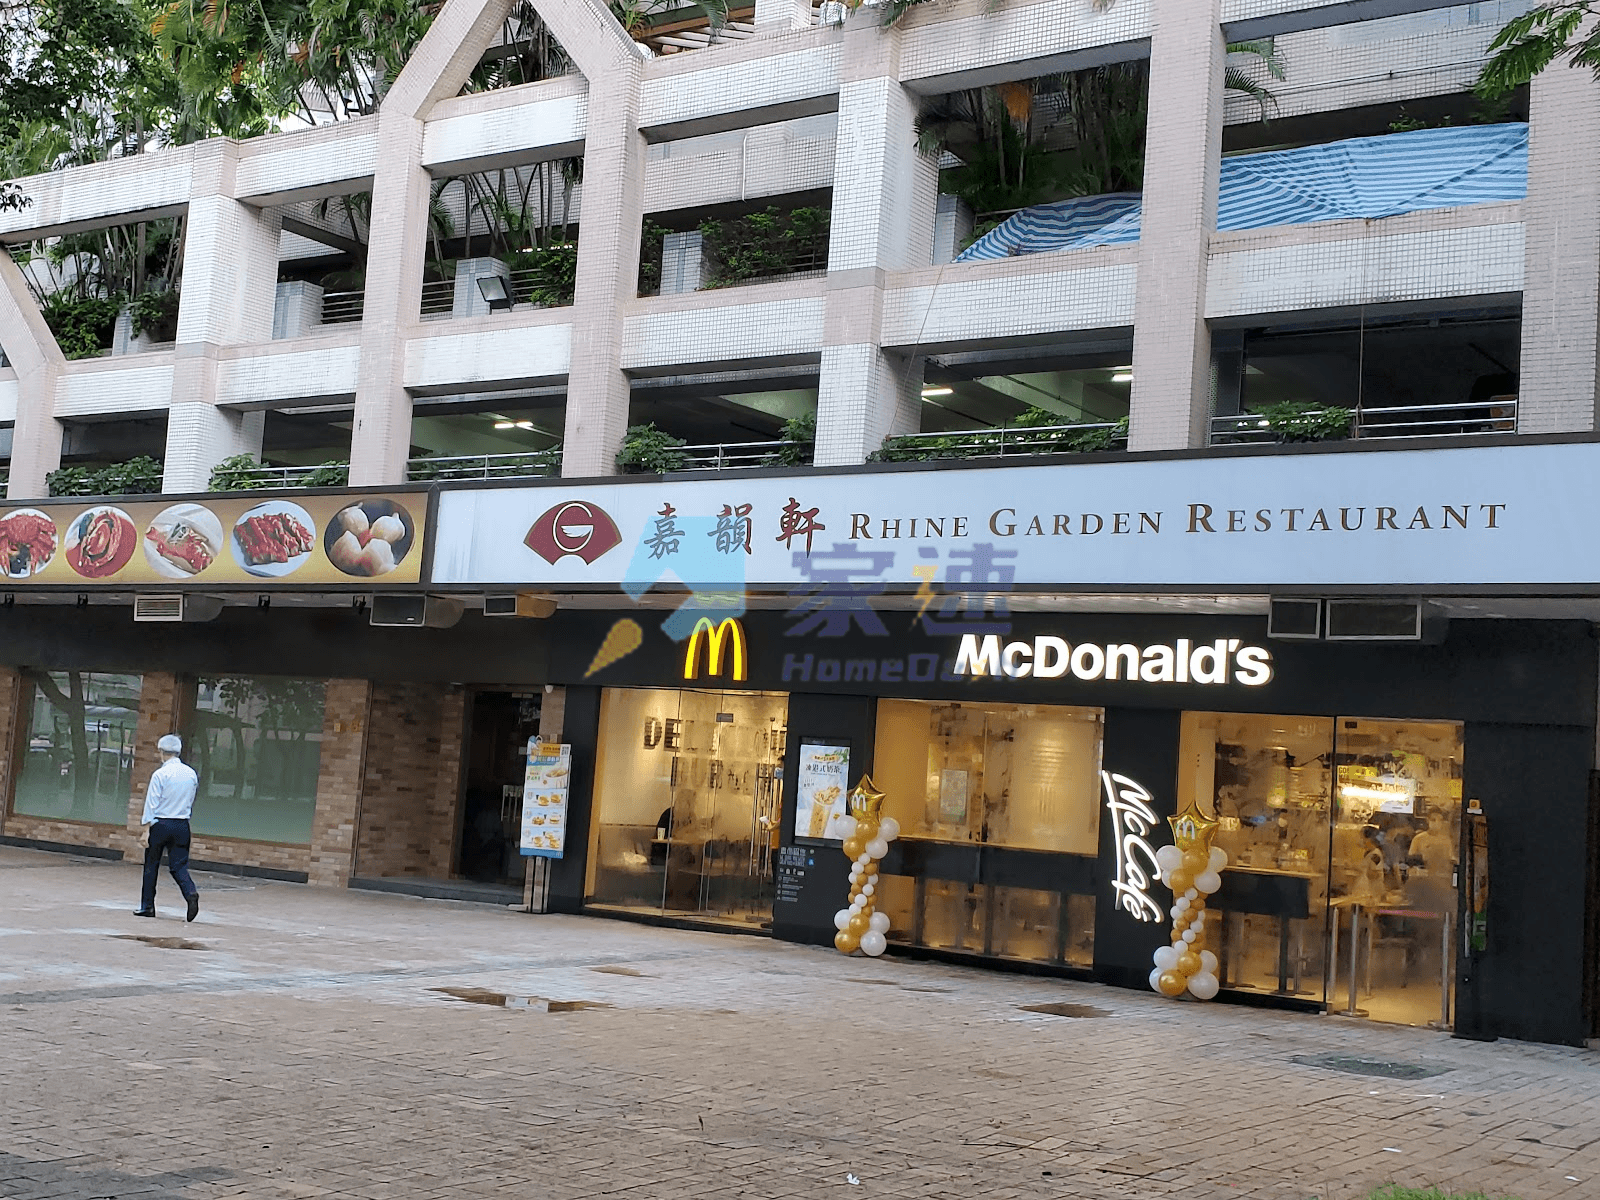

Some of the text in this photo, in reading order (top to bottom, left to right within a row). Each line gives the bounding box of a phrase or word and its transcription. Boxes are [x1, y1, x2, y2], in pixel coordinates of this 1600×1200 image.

[644, 497, 826, 559] 嘉韻軒
[849, 503, 1507, 539] RHINE GARDEN RESTAURANT
[953, 634, 1273, 686] McDonald's
